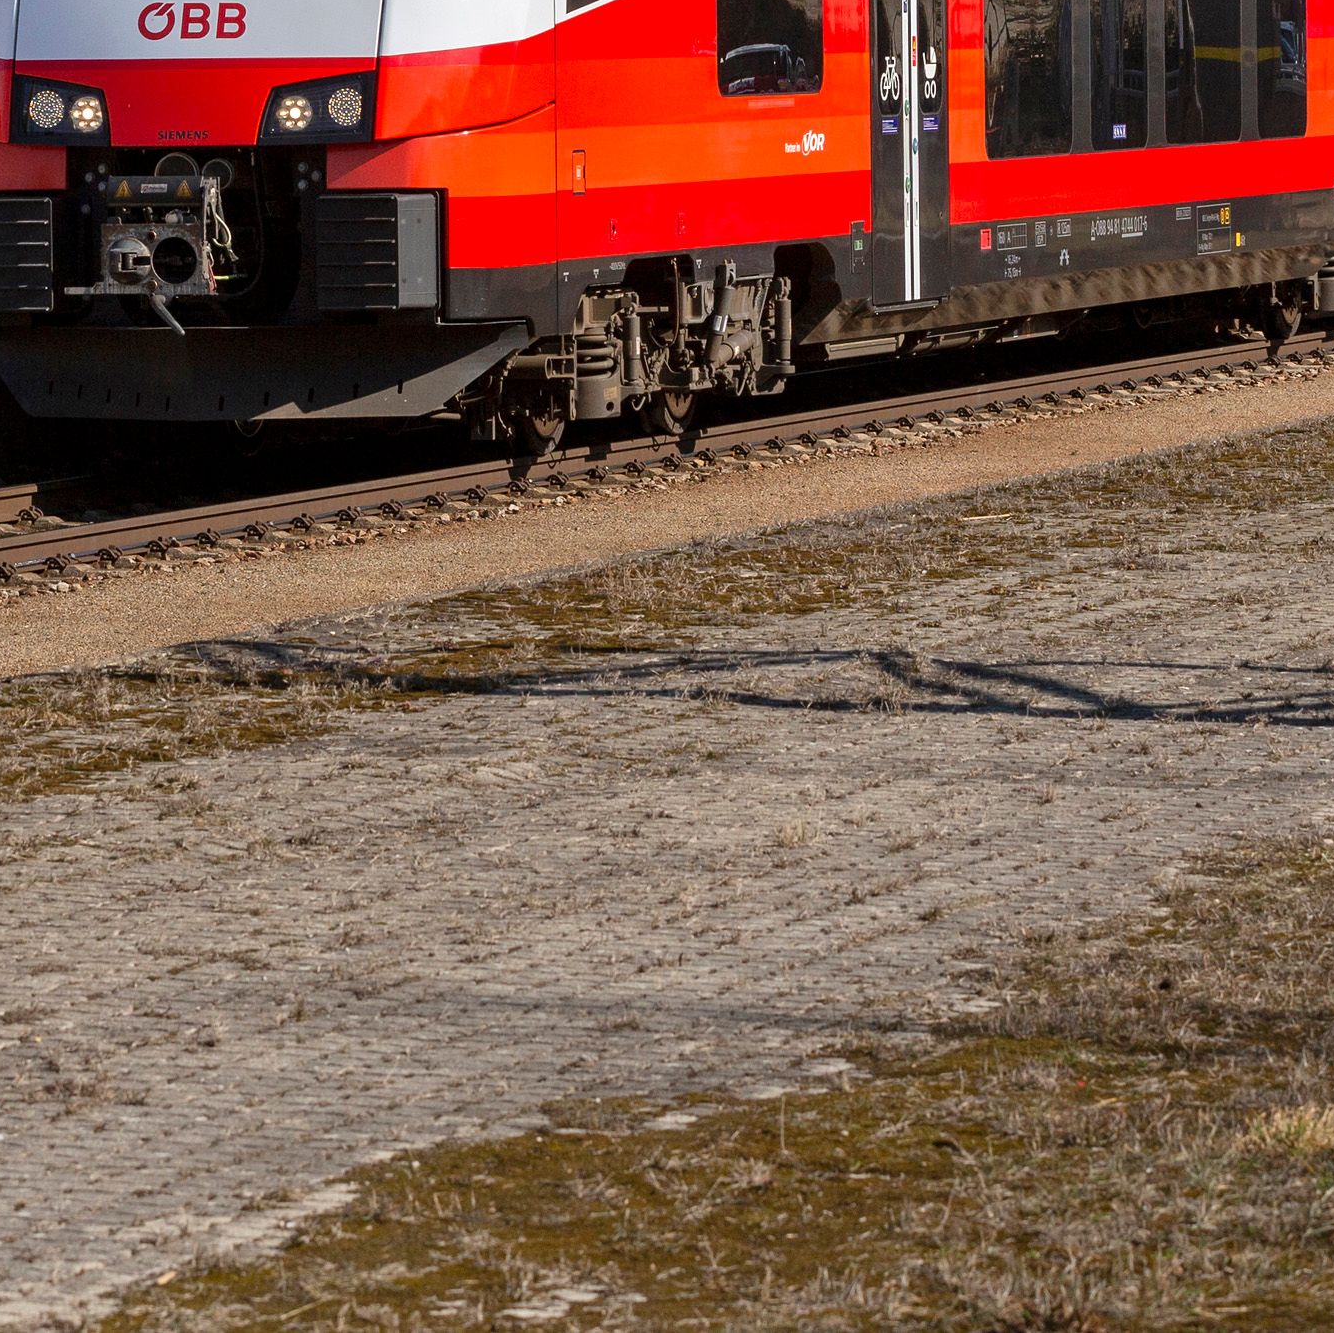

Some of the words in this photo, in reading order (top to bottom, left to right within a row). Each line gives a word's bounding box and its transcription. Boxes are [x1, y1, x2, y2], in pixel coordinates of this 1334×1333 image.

[137, 1, 247, 41] ÖBB
[158, 130, 210, 140] SIEMENS
[801, 130, 825, 156] VOR
